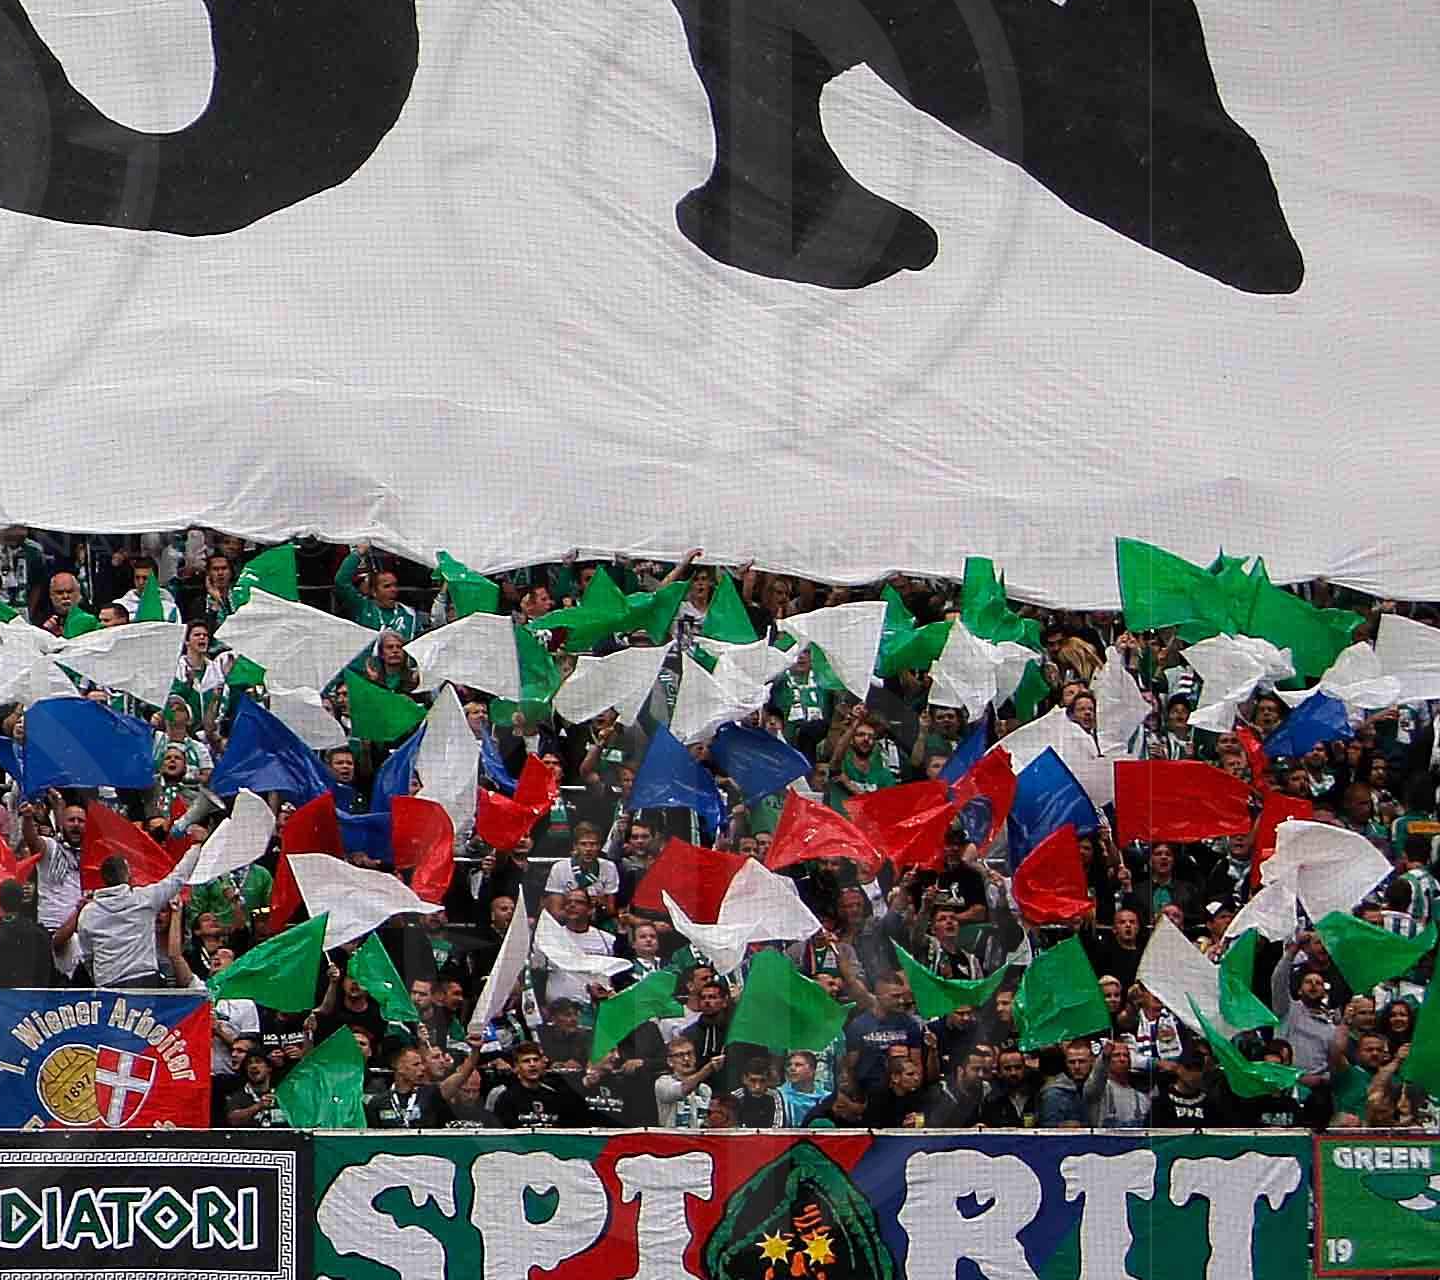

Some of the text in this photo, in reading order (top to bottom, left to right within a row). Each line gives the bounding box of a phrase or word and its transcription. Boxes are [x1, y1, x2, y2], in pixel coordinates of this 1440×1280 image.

[9, 998, 104, 1052] Wiener
[63, 1073, 94, 1106] 1897
[1332, 1146, 1432, 1170] GREEN
